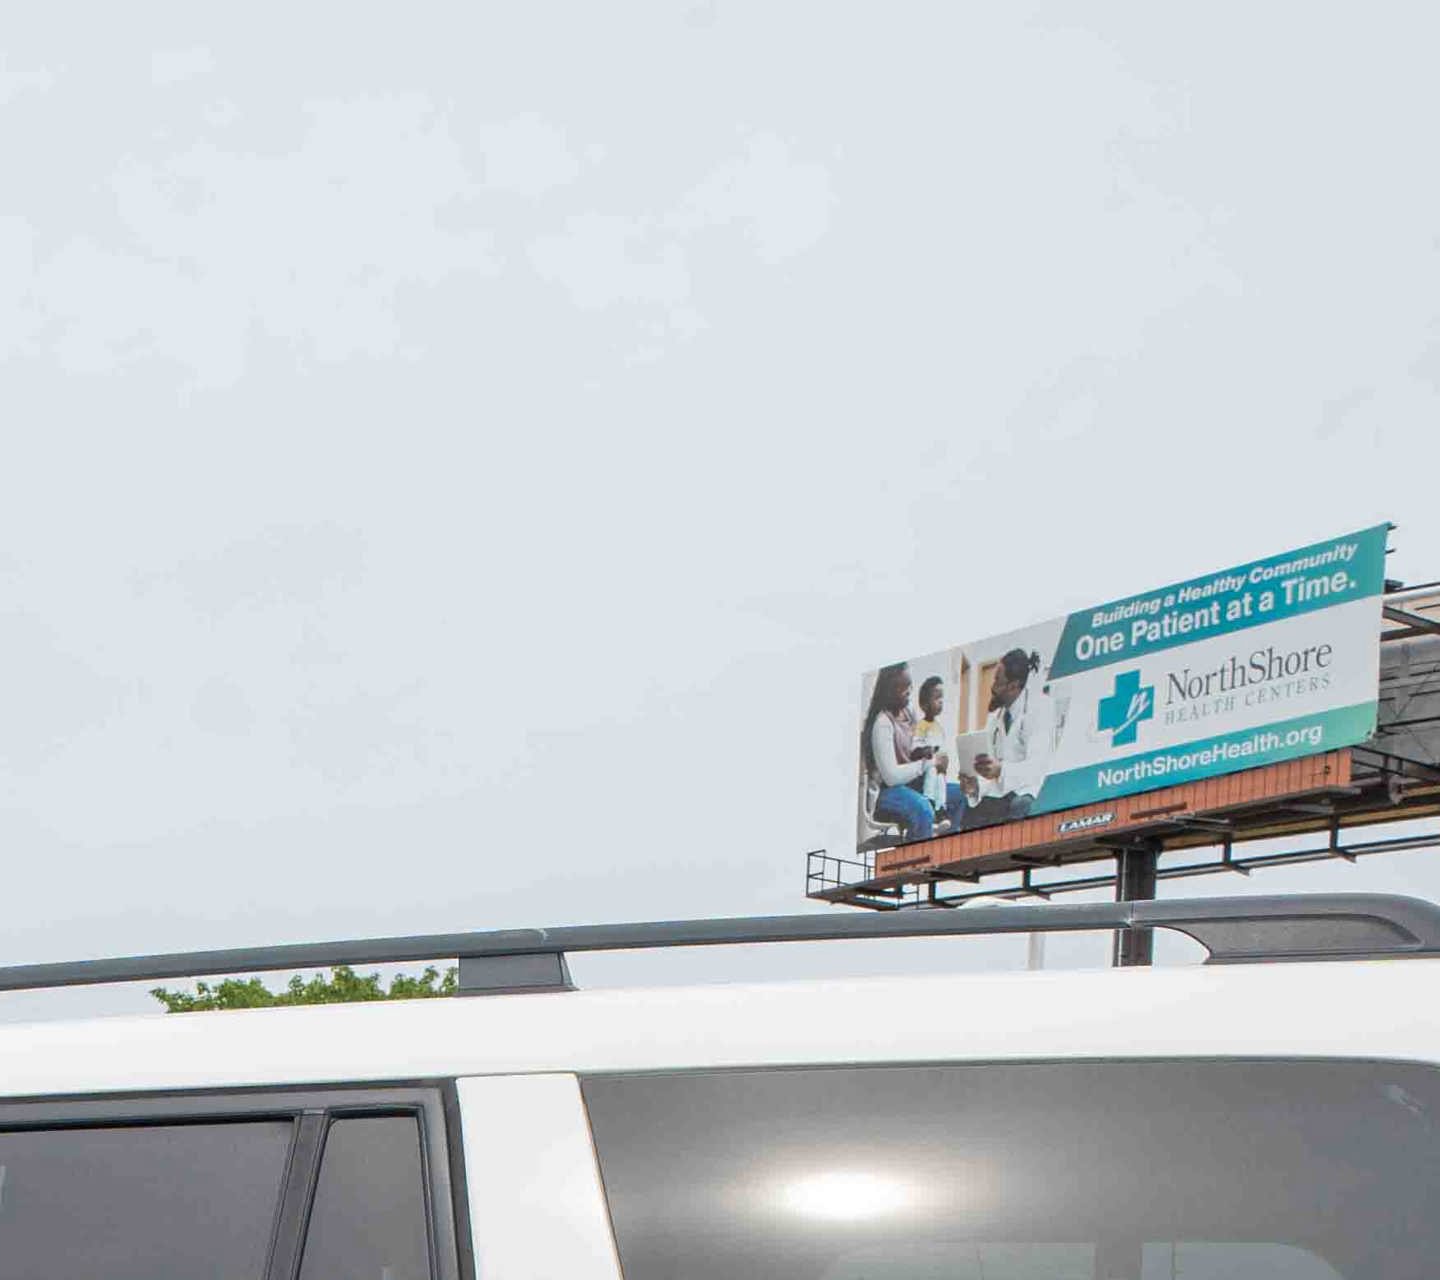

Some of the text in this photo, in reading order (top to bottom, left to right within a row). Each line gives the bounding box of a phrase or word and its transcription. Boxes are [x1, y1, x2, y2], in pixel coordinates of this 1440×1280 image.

[1076, 570, 1357, 660] One Patient at a Time.
[1091, 542, 1358, 628] Building a Healthy Community
[1164, 674, 1331, 725] HEALTH CENTERS
[1167, 643, 1332, 705] NorthShore
[1097, 724, 1322, 787] NorthShoreHealth.org
